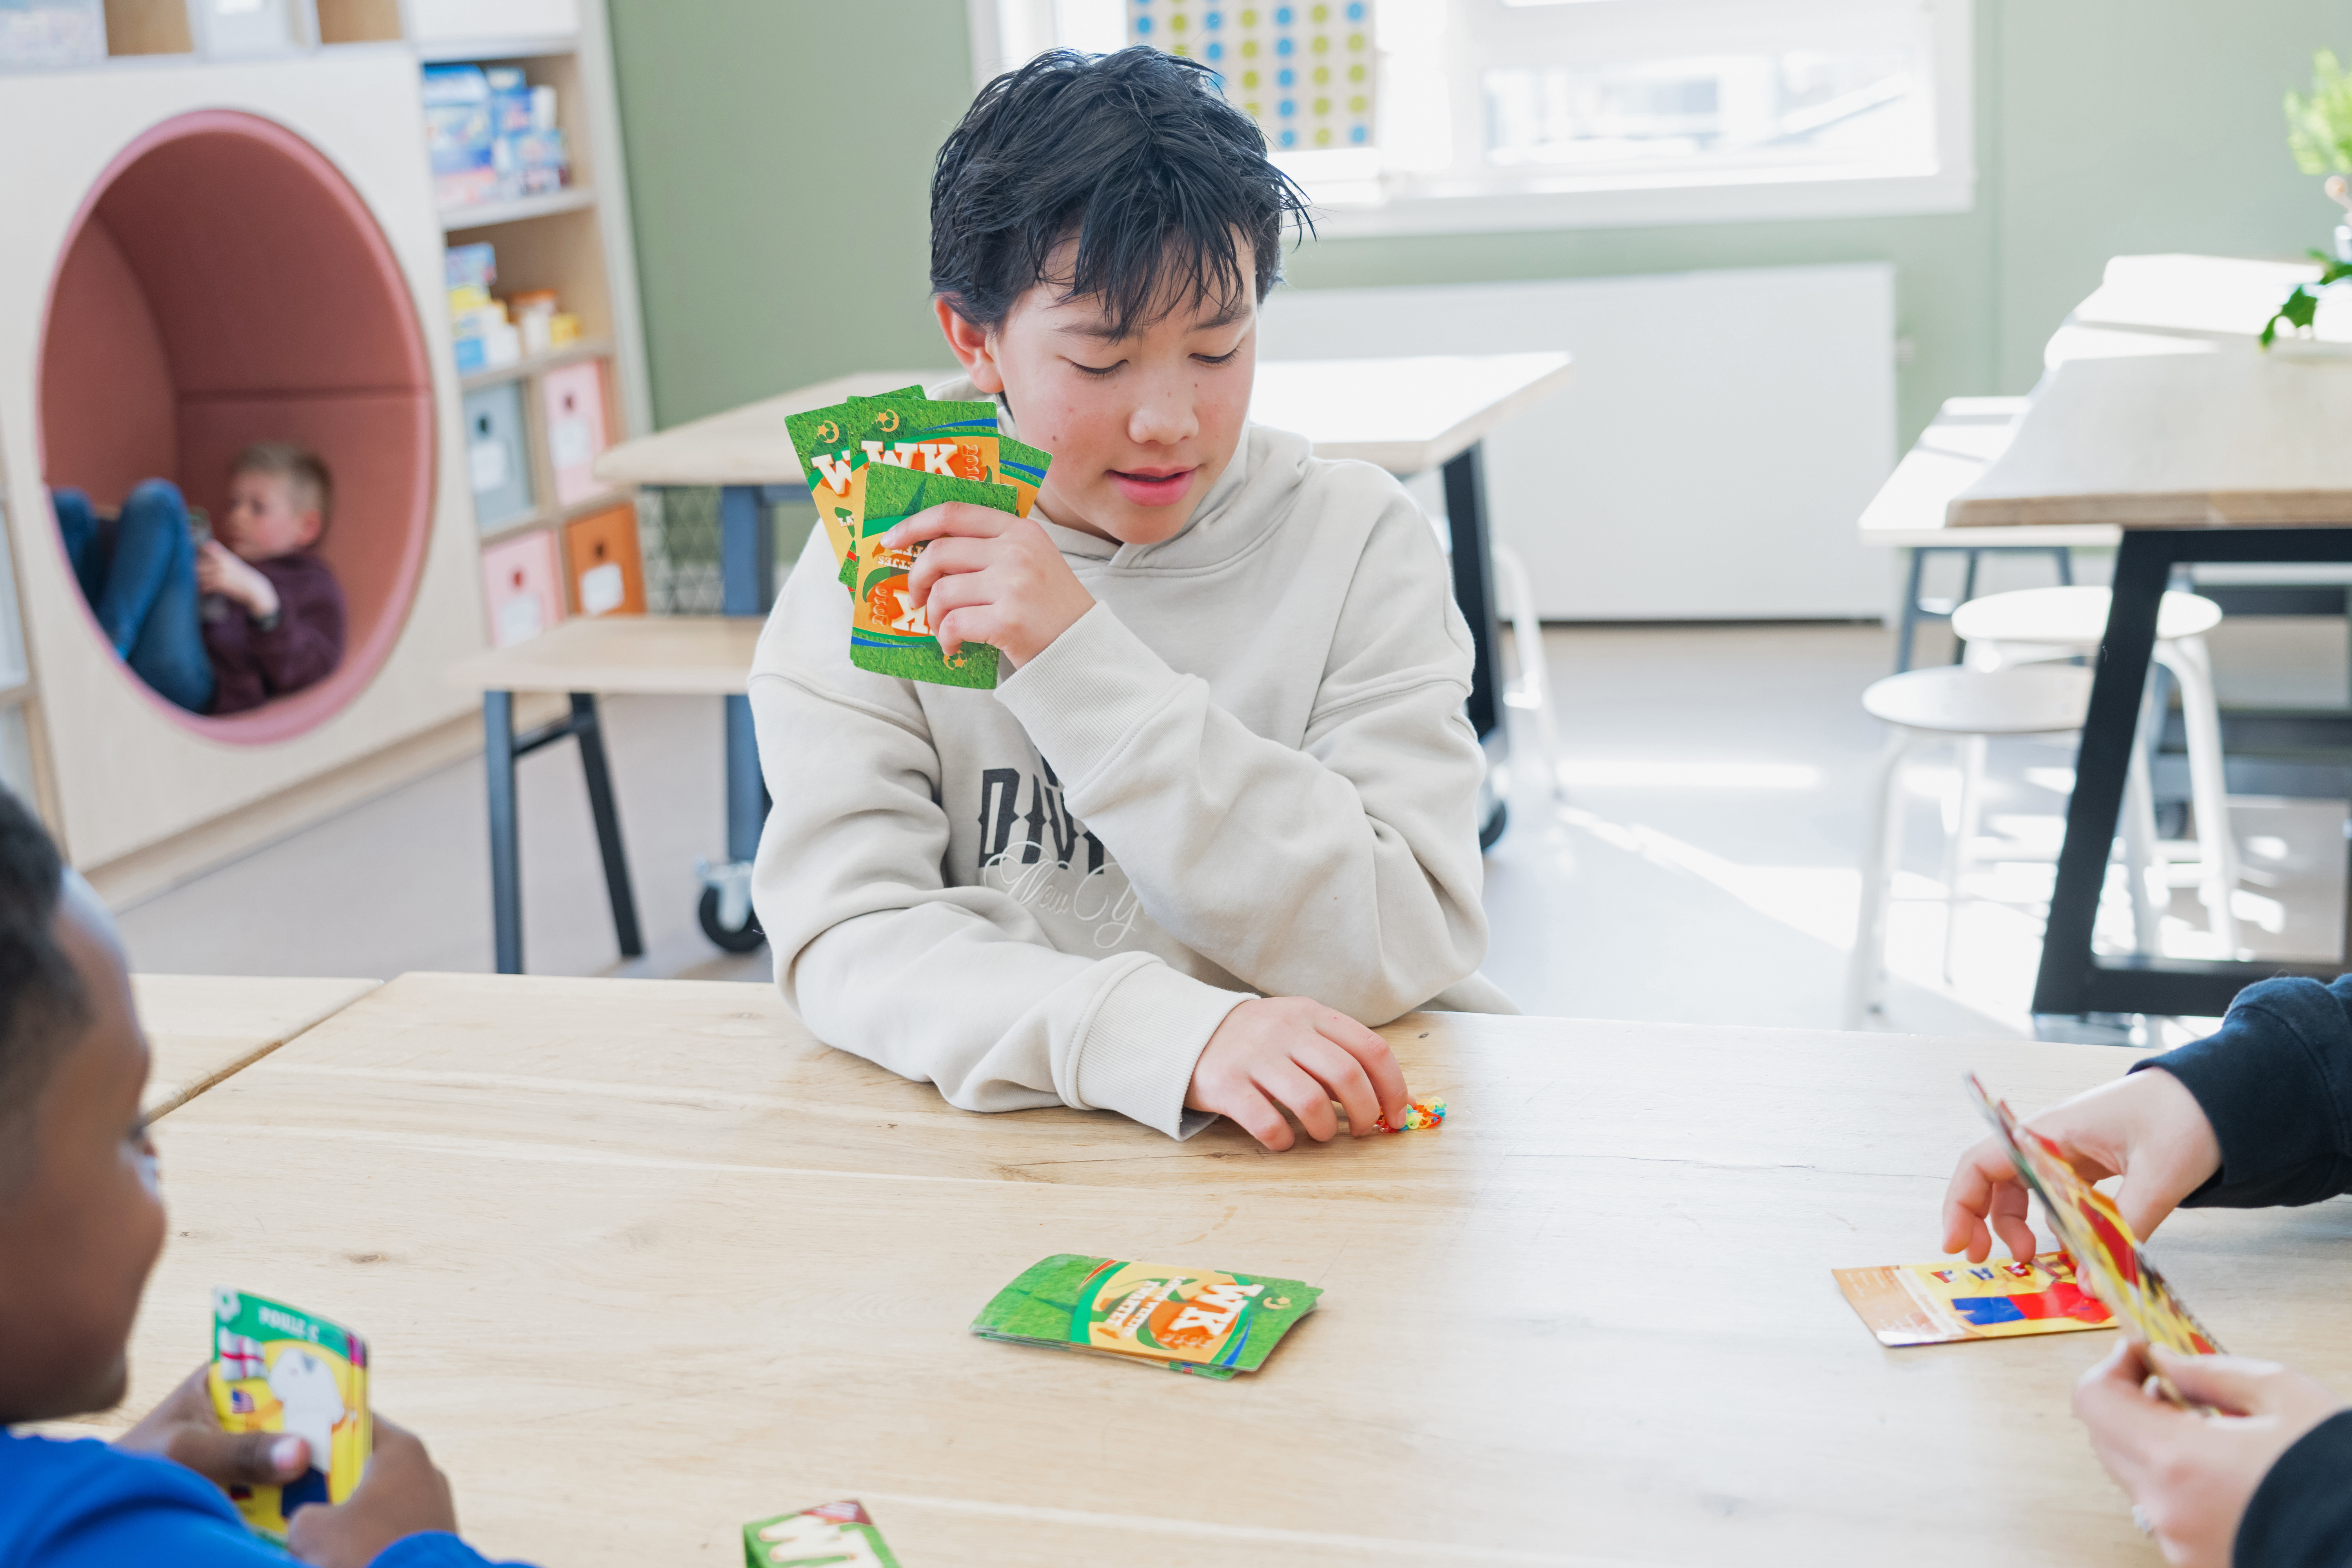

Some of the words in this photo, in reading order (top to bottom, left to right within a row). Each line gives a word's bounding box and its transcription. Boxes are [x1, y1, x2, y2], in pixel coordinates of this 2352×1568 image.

[811, 450, 852, 495] W
[872, 585, 890, 627] 2010
[1104, 1280, 1161, 1327] KWARTET
[1168, 1283, 1265, 1336] WK
